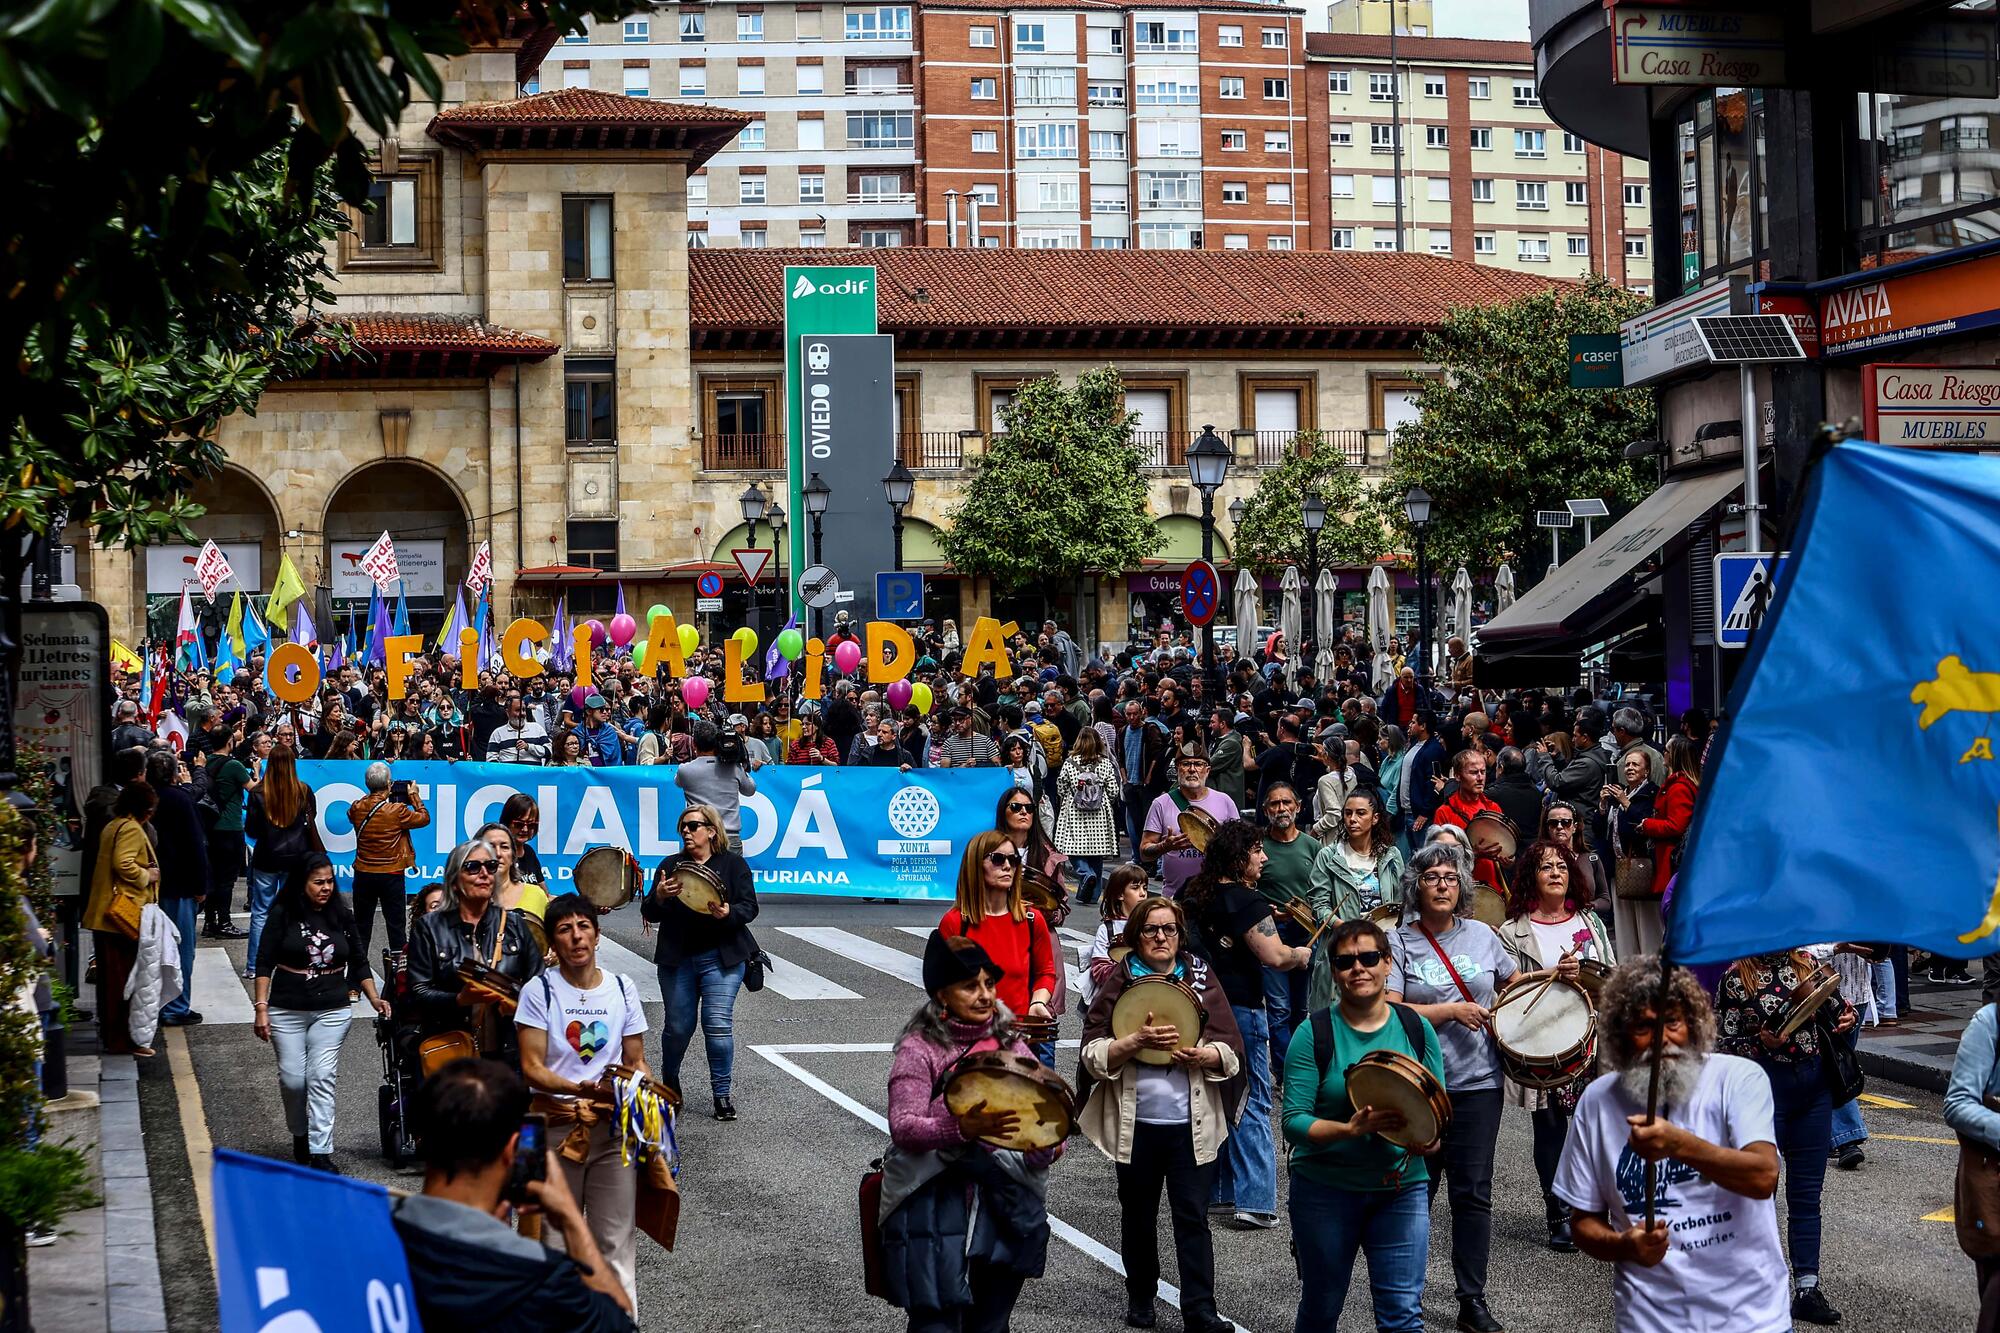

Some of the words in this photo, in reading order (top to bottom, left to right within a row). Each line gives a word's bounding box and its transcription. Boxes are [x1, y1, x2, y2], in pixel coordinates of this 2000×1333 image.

[1658, 14, 1743, 33] MUEBLES
[1641, 51, 1691, 75] Casa
[1698, 51, 1761, 83] Riesgo
[819, 279, 870, 295] adif
[1825, 282, 1892, 329] AVATA
[1788, 314, 1817, 328] ATA
[1825, 320, 1892, 342] HISPANIA
[1866, 337, 1873, 346] de
[1873, 334, 1898, 345] accidentes
[1898, 330, 1905, 340] de
[1922, 328, 1927, 338] y
[1927, 319, 1957, 335] asegurados
[1582, 351, 1619, 363] caser
[1882, 375, 1933, 400] Casa
[1939, 375, 2000, 406] Riesgo
[810, 383, 831, 459] OVIEDO
[1901, 421, 1987, 439] MUEBLES
[887, 579, 912, 610] P
[23, 633, 90, 647] Selmana
[29, 649, 91, 664] Lletres
[20, 666, 92, 682] urianes
[314, 772, 849, 860] OICIALDÁ
[899, 842, 930, 853] XUNTA
[891, 865, 899, 873] DE
[901, 865, 910, 873] LA
[912, 865, 938, 873] LLINGUA
[892, 857, 908, 865] POLA
[910, 857, 937, 865] DEFENSA
[405, 866, 446, 879] OLA
[753, 869, 851, 884] TURIANA
[565, 1008, 608, 1016] OFICIALIDÁ
